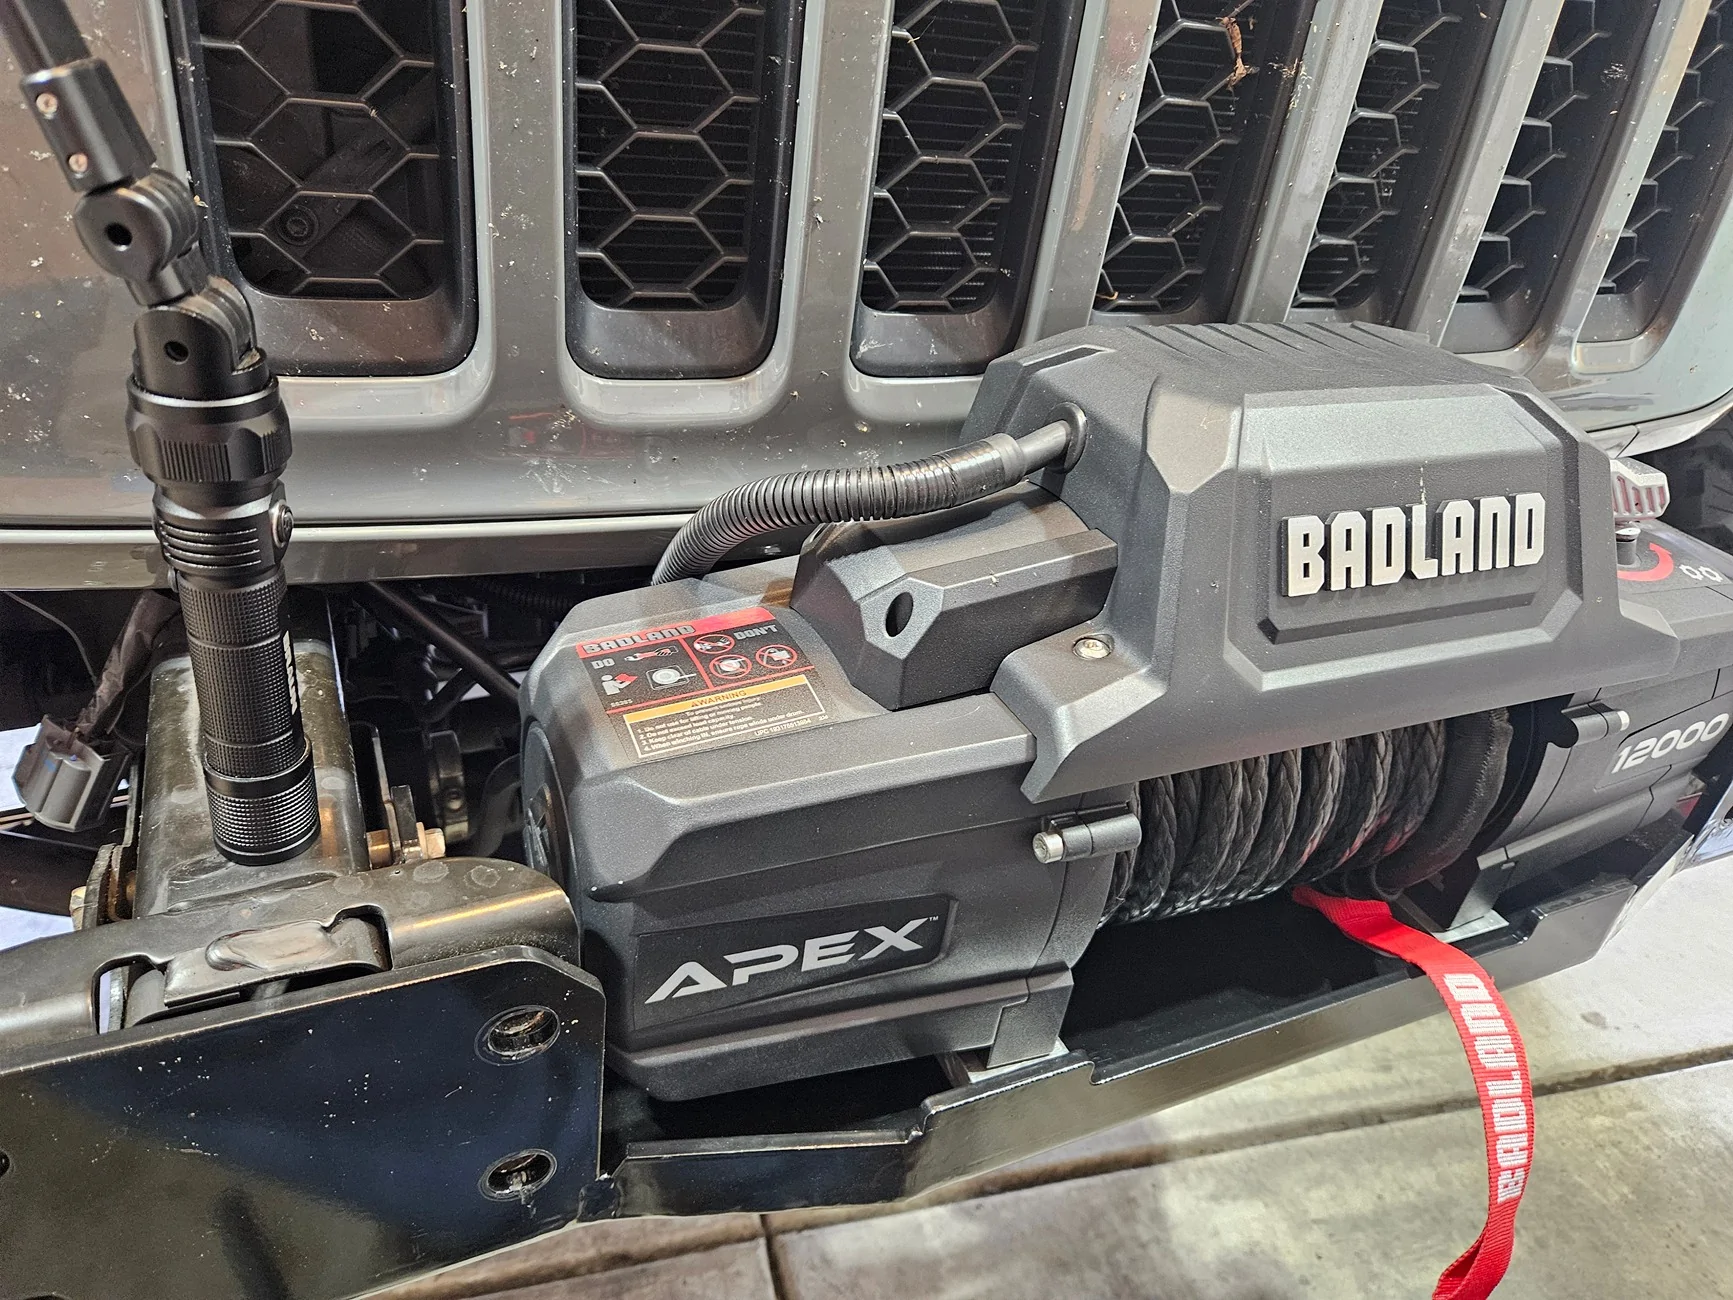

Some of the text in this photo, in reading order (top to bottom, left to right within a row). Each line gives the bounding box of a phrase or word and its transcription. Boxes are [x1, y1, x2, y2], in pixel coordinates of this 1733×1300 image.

[1284, 492, 1545, 597] BADLAND
[583, 625, 697, 654] BADLAND
[733, 625, 779, 641] DON'T
[590, 658, 616, 670] DO
[697, 690, 747, 706] WARNING
[1611, 712, 1730, 774] 12000
[644, 917, 928, 1004] APEX
[1442, 973, 1528, 1205] BADLAND
